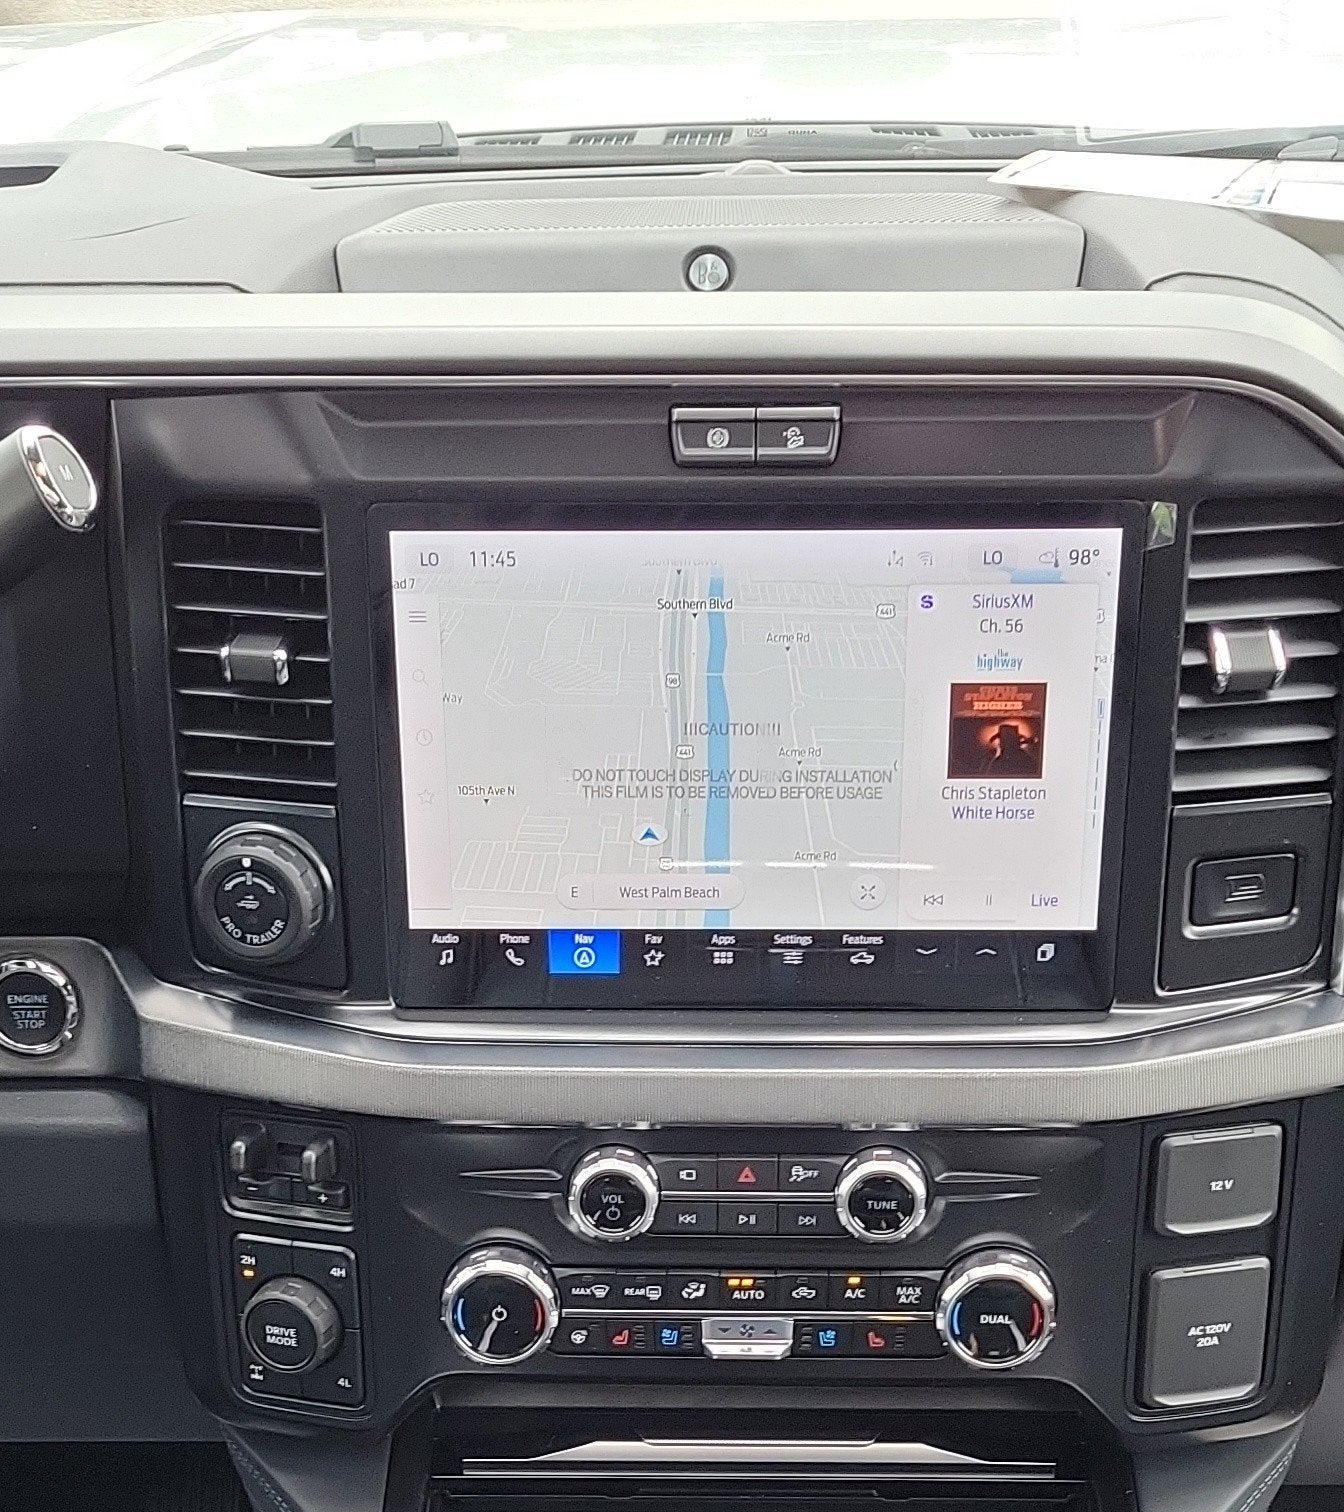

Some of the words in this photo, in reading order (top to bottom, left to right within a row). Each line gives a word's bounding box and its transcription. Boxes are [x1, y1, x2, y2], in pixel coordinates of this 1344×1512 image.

[420, 552, 439, 567] LO
[469, 550, 517, 568] 11:45
[983, 550, 1003, 566] LO
[657, 598, 707, 610] Southern
[709, 598, 733, 610] Blvd
[972, 594, 1034, 609] SiriusXM
[979, 619, 1003, 633] Ch.
[1005, 619, 1024, 633] 56
[766, 632, 794, 644] Acme
[796, 632, 810, 644] Rd
[977, 653, 1023, 671] highway
[778, 746, 806, 758] Acme
[807, 746, 821, 758] Rd
[572, 768, 593, 782] DO
[595, 768, 626, 782] NOT
[627, 769, 676, 783] TOUCH
[679, 769, 735, 783] DISPLAY
[795, 770, 893, 784] INSTALLATION
[457, 785, 486, 797] 105th
[487, 785, 505, 797] Ave
[506, 785, 516, 797] N
[584, 786, 613, 799] THIS
[615, 786, 650, 799] FILM
[651, 786, 664, 799] IS
[667, 786, 686, 799] TO
[688, 786, 707, 799] BE
[709, 786, 777, 800] REMOVED
[780, 787, 834, 800] BEFORE
[836, 787, 883, 800] USAGE
[941, 786, 976, 801] Chris
[978, 786, 1047, 803] Stapleton
[952, 806, 993, 820] White
[995, 806, 1036, 820] Horse
[794, 851, 822, 862] Acme
[823, 851, 838, 862] Rd
[570, 887, 579, 898] E
[619, 886, 649, 899] West
[651, 886, 682, 899] Palm
[684, 886, 721, 899] Beach
[1030, 894, 1059, 908] Live
[219, 915, 244, 940] PRO
[244, 919, 286, 946] TRAILER
[431, 933, 460, 945] Audio
[499, 933, 531, 945] Phone
[574, 933, 594, 945] Nav
[644, 933, 664, 945] Fav
[710, 933, 736, 947] Apps
[773, 933, 813, 947] Settings
[841, 933, 884, 946] Features
[6, 993, 49, 1005] ENGINE
[12, 1010, 47, 1021] START
[16, 1019, 46, 1030] STOP
[601, 1194, 625, 1205] VOL
[866, 1200, 899, 1211] TUNE
[239, 1254, 257, 1266] 2H
[329, 1267, 347, 1279] 4H
[571, 1287, 592, 1297] MAX
[624, 1287, 646, 1297] REAR
[731, 1289, 765, 1301] AUTO
[843, 1288, 867, 1300] A/C
[896, 1286, 922, 1296] MAX
[898, 1294, 921, 1304] A/C
[979, 1314, 1012, 1325] DUAL
[265, 1324, 298, 1338] DRIVE
[1187, 1325, 1205, 1337] AC
[1204, 1322, 1232, 1335] 120V
[266, 1335, 299, 1347] MODE
[1196, 1336, 1220, 1348] 20A
[337, 1377, 353, 1388] 4L
